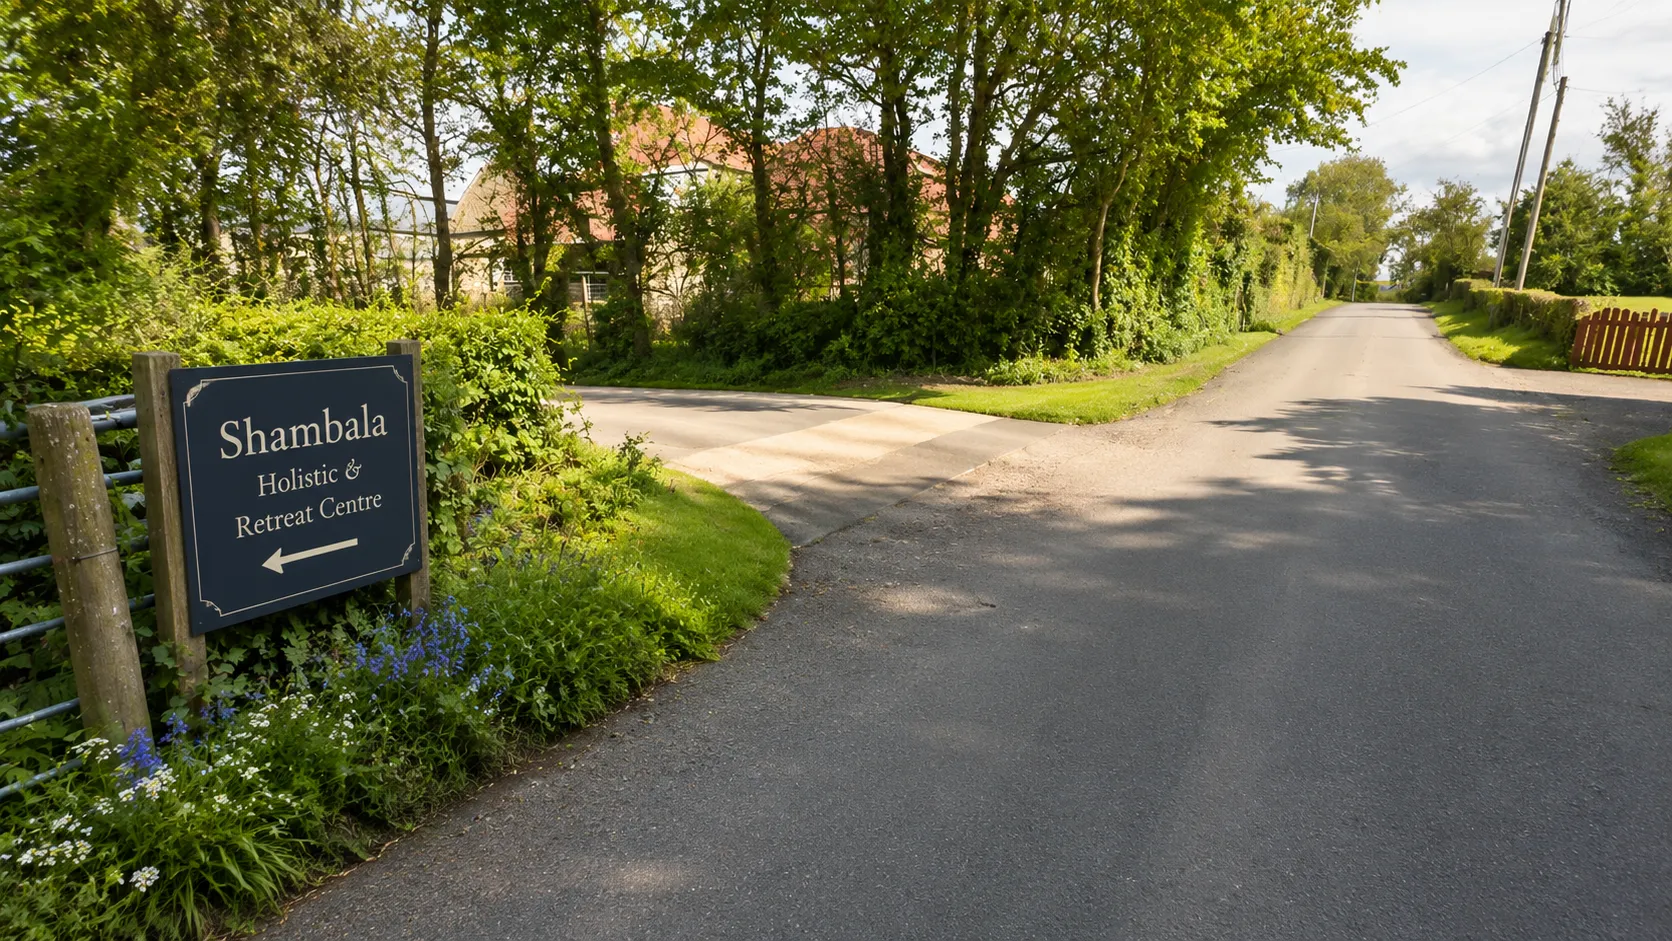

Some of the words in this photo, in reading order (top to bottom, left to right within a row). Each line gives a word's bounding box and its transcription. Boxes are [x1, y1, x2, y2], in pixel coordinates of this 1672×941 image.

[220, 403, 388, 459] Shambala
[257, 464, 339, 497] Holistic
[345, 458, 362, 480] &
[235, 505, 314, 539] Retreat
[319, 493, 382, 519] Centre
